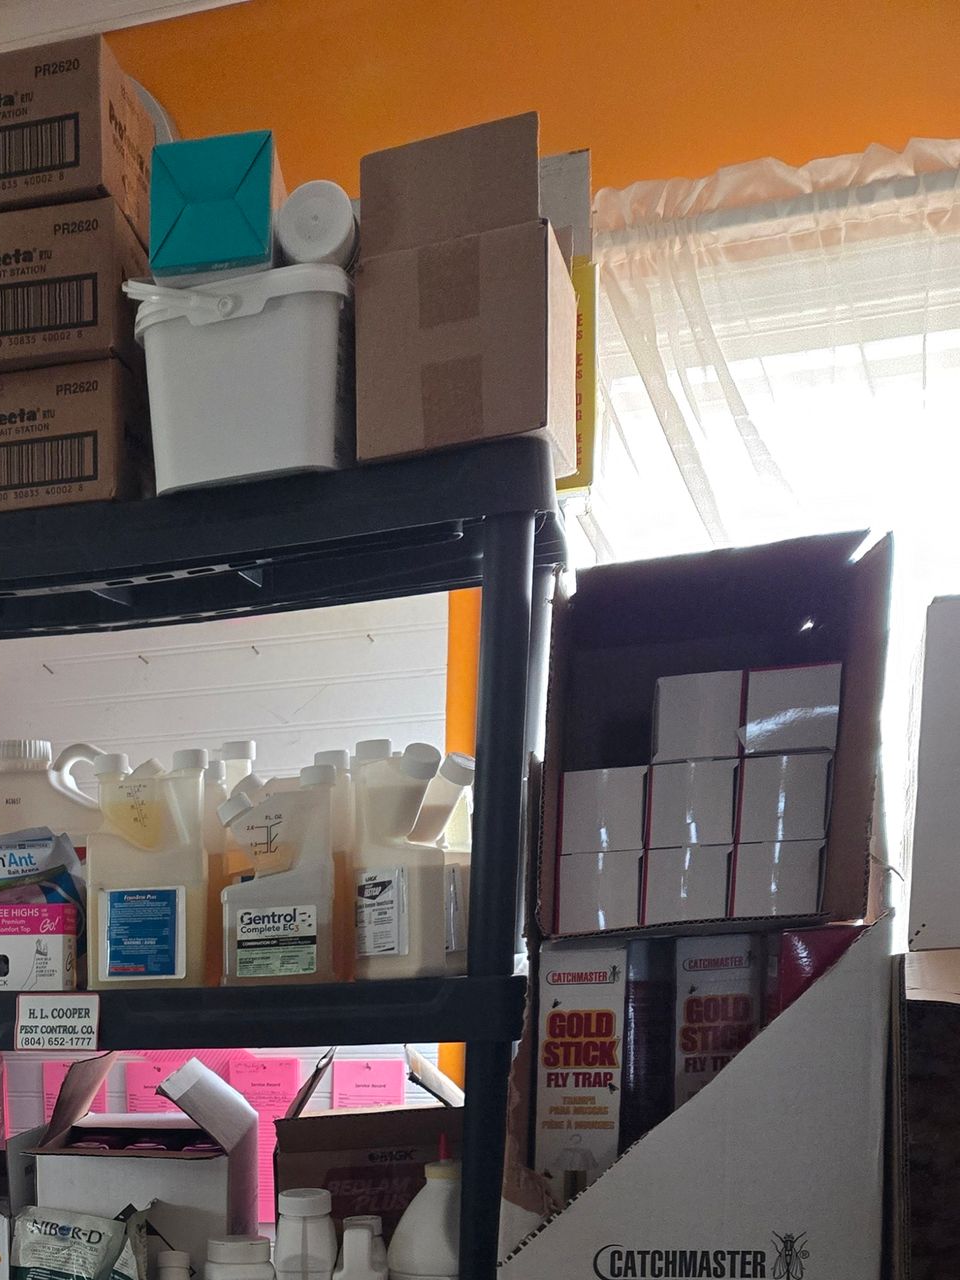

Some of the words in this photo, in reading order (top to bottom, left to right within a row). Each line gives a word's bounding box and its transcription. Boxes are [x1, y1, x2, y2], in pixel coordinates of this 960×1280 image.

[34, 59, 80, 78] PR2620
[24, 175, 52, 186] 40002
[54, 219, 99, 235] PR2620
[10, 264, 47, 277] STATION
[8, 336, 36, 346] 30835
[43, 333, 71, 342] 40002
[56, 380, 98, 396] PR2620
[15, 423, 50, 434] STATION
[45, 486, 72, 497] 40002
[8, 853, 36, 868] Ant
[11, 908, 39, 917] HIGHS
[240, 908, 296, 925] Gentrol
[40, 918, 60, 933] Go!
[241, 925, 280, 934] Complete
[689, 957, 744, 970] CATCHMASTER
[552, 971, 608, 983] CATCHMASTER
[28, 1009, 38, 1019] H.
[40, 1008, 48, 1019] L.
[51, 1008, 90, 1019] COOPER
[687, 997, 753, 1023] GOLD
[20, 1025, 39, 1034] PEST
[40, 1025, 78, 1034] CONTROL
[81, 1025, 94, 1034] CO.
[549, 1012, 615, 1038] GOLD
[21, 1037, 45, 1047] (804)
[48, 1037, 92, 1046] 652-1777
[544, 1040, 619, 1067] STICK
[685, 1056, 706, 1073] FLY
[546, 1073, 569, 1088] FLY
[573, 1072, 614, 1088] TRAP
[608, 1248, 767, 1280] CATCHMASTER
